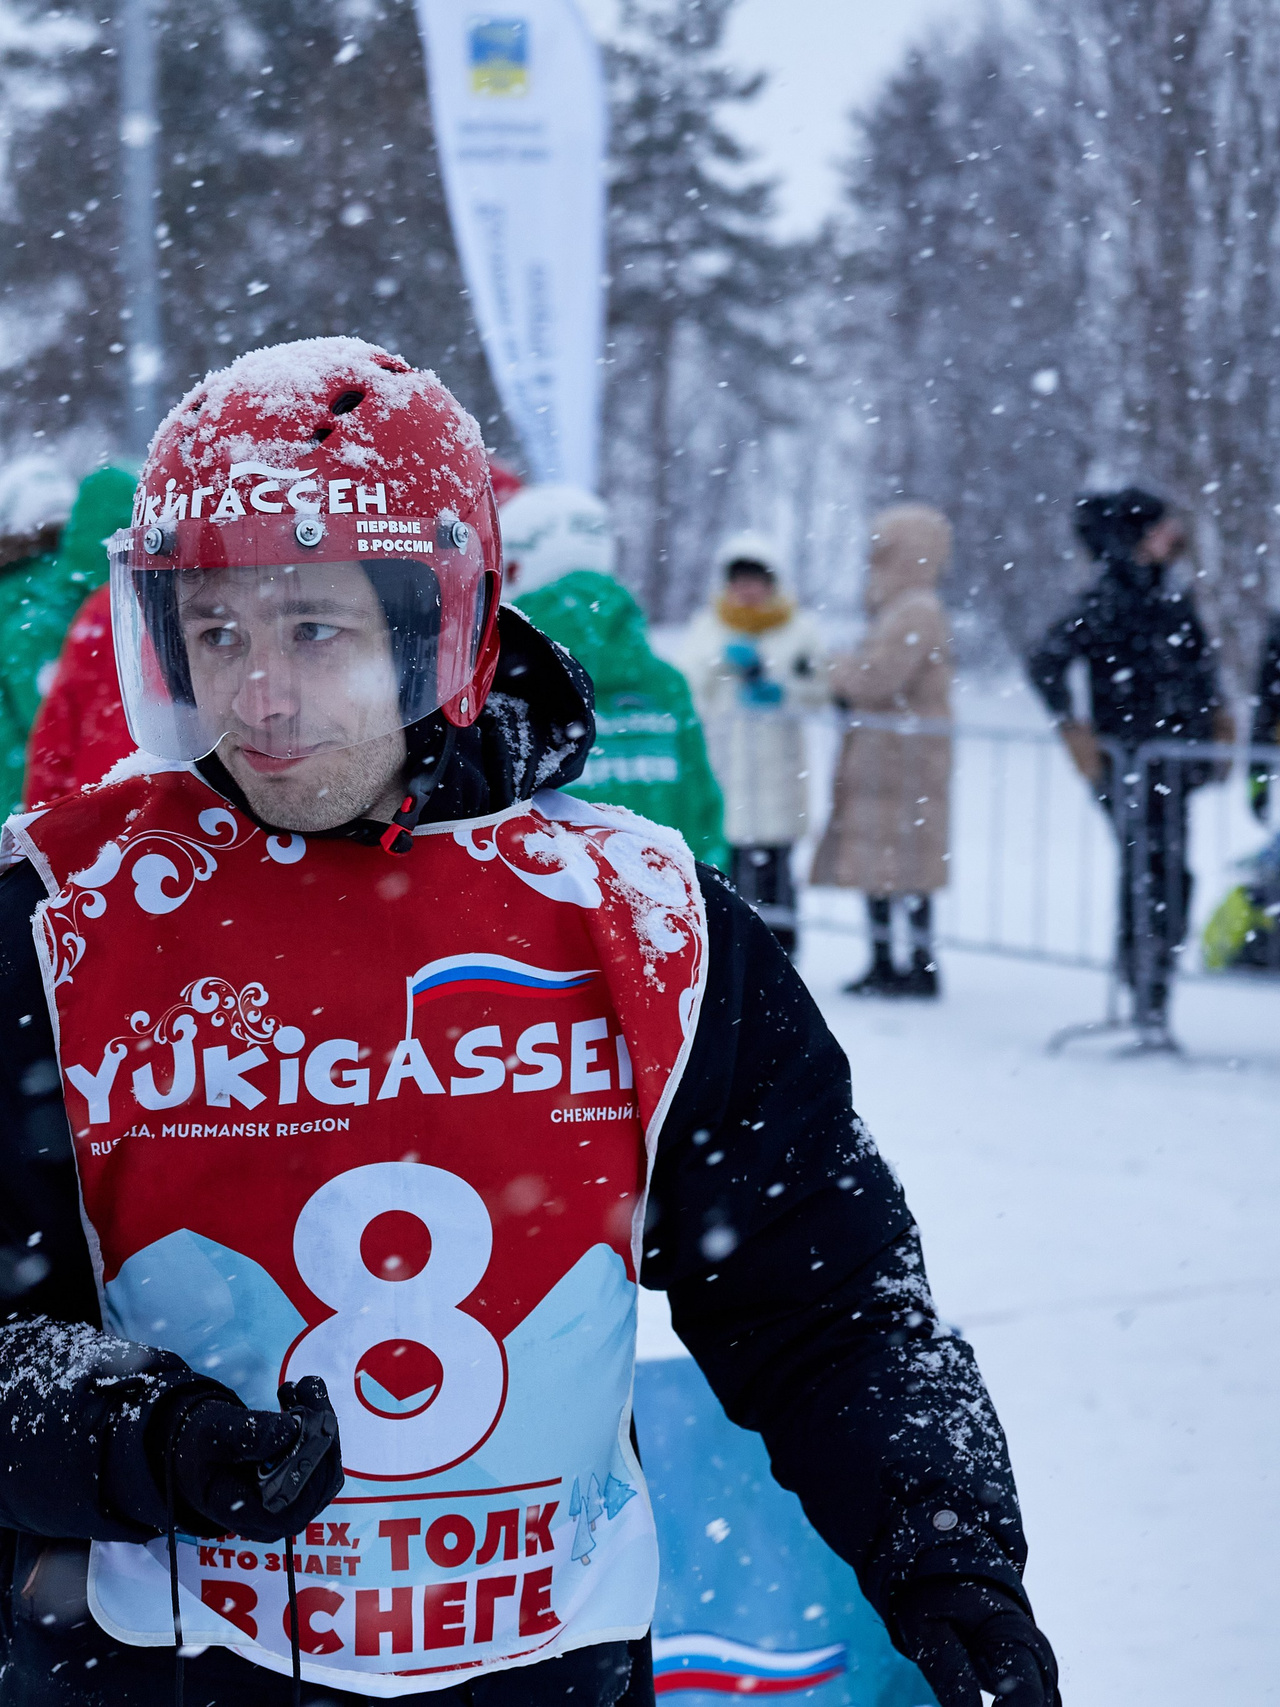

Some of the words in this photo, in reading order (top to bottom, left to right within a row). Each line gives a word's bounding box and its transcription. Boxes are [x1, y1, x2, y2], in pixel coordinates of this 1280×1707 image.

[356, 520, 421, 534] ПЕРВЫЕ
[357, 539, 369, 552] В
[371, 539, 434, 554] РОССИИ
[550, 1102, 633, 1123] СНЕЖНЫЙ
[161, 1121, 270, 1139] MURMANSK
[276, 1117, 350, 1137] REGION
[278, 1161, 509, 1482] 8
[378, 1501, 560, 1571] ТОЛК
[199, 1546, 258, 1570] КТО
[282, 1565, 562, 1657] СНЕГЕ
